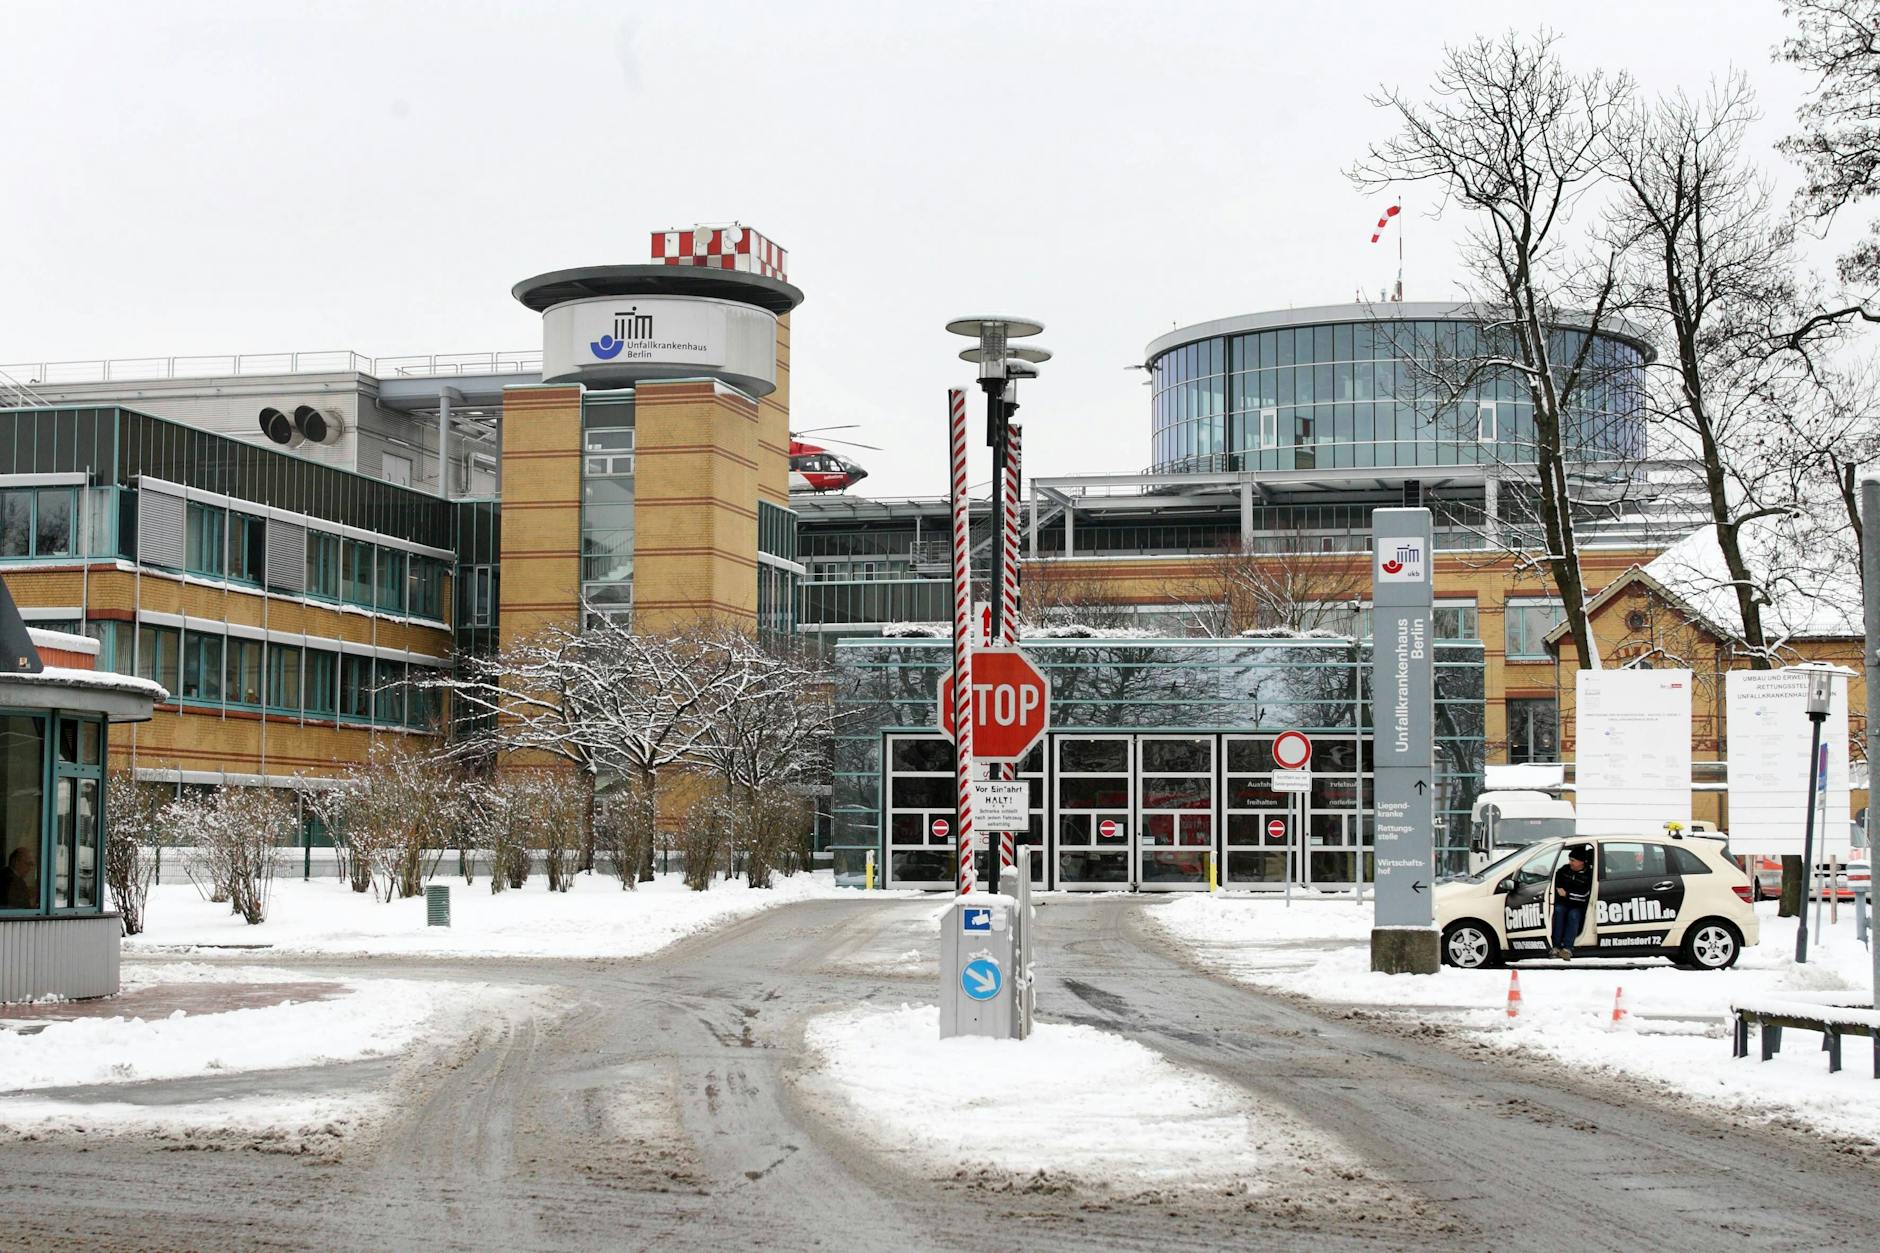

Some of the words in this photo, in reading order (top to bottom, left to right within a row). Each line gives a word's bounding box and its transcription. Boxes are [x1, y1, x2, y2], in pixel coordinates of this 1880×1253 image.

[627, 341, 707, 352] Unfallkrankenhaus
[627, 350, 652, 359] Berlin
[1411, 618, 1424, 660] Berlin
[1395, 618, 1409, 752] Unfallkrankenhaus
[950, 683, 1040, 726] TOP
[975, 785, 988, 793] Vor
[985, 796, 1013, 804] HALT!
[1377, 802, 1410, 811] Liegend-
[1377, 824, 1415, 833] Rettungs-
[1377, 832, 1399, 840] stelle
[1377, 859, 1425, 867] Wirtschafts-
[1377, 867, 1391, 875] hof
[1596, 897, 1676, 923] Berlin.de
[1600, 938, 1612, 947] Alt
[1612, 936, 1651, 946] Kaulsdorf
[1652, 935, 1662, 945] 72
